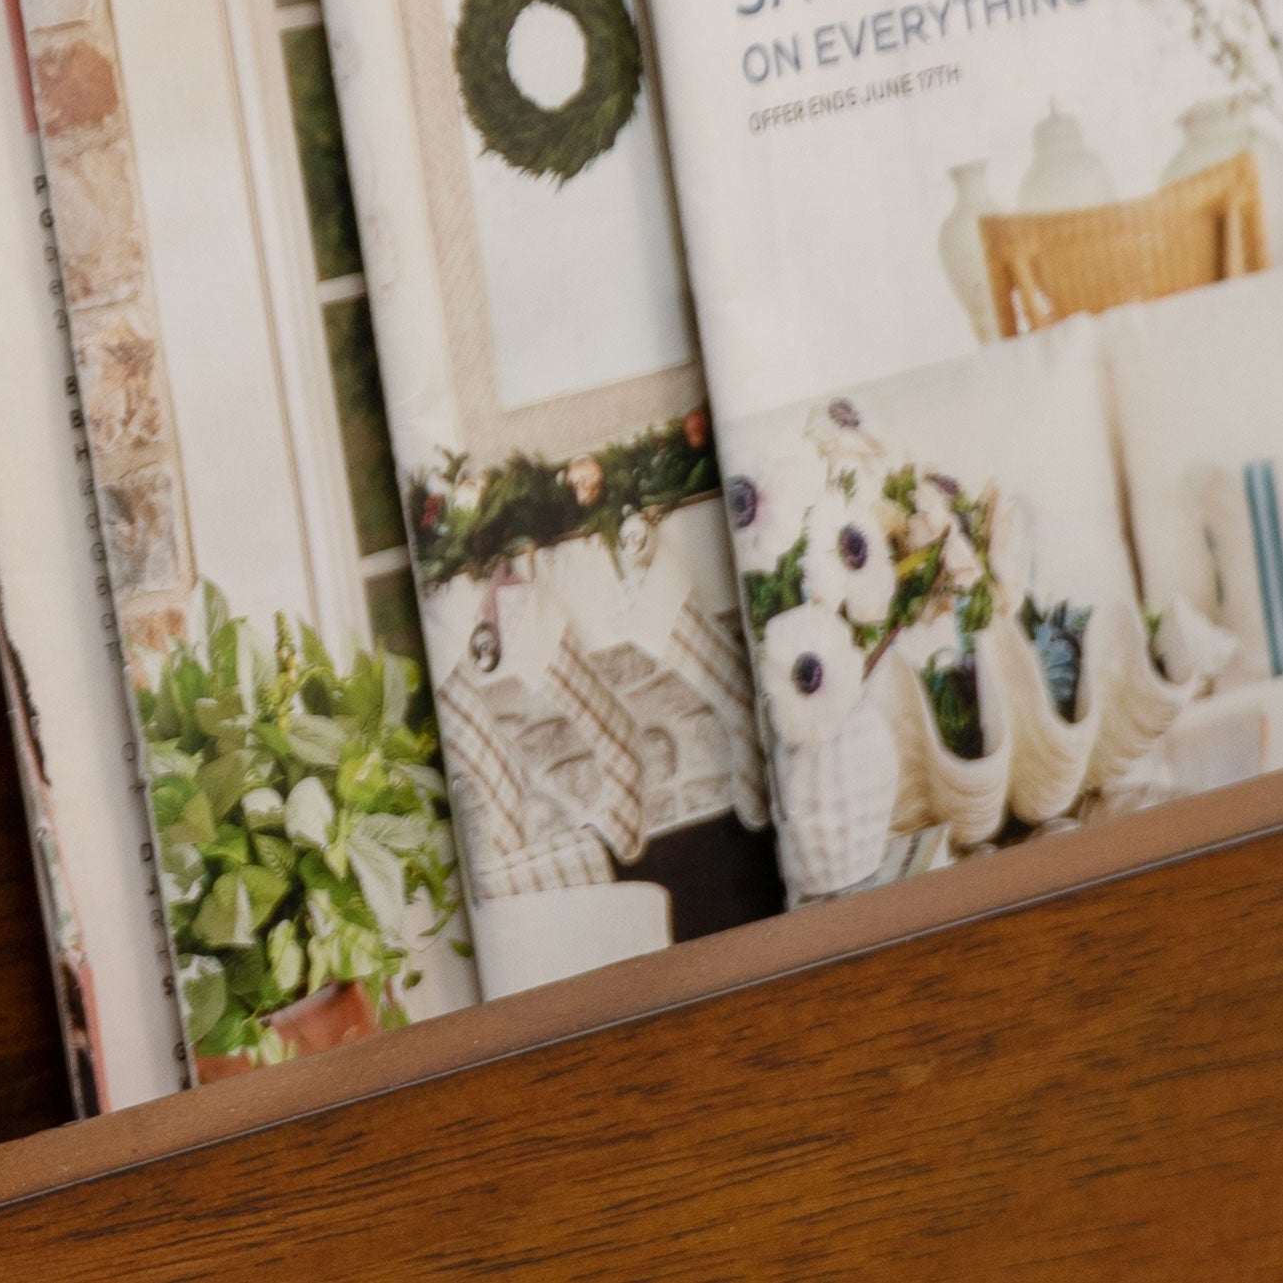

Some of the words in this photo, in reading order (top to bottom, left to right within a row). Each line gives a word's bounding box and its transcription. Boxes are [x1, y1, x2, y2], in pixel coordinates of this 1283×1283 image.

[742, 34, 801, 83] ON
[749, 99, 805, 134] OFFER
[808, 86, 858, 118] ENDS
[863, 72, 913, 103] JUNE
[917, 62, 962, 92] 17TH
